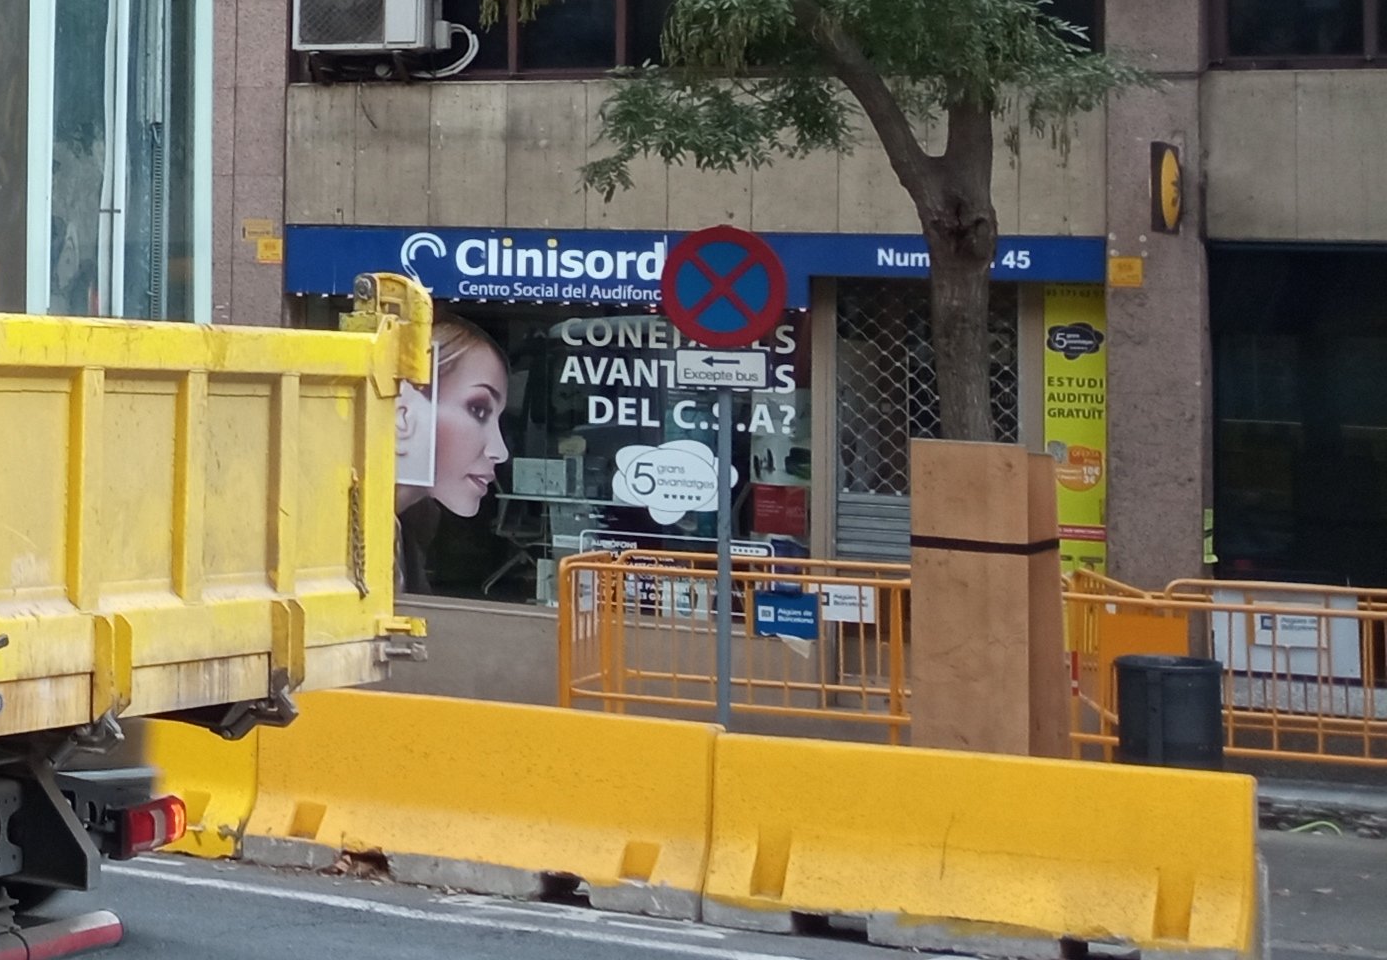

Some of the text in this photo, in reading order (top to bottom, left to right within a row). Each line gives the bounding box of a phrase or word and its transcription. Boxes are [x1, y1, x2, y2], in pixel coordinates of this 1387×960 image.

[455, 237, 665, 281] Clinisord
[1001, 250, 1031, 269] 45
[458, 280, 511, 297] Centro
[513, 281, 559, 299] Social
[561, 283, 587, 299] del
[1055, 332, 1067, 349] 5
[683, 368, 759, 382] Excepte bus
[1047, 376, 1104, 389] ESTUDI
[1047, 392, 1104, 404] AUDITIU
[588, 395, 660, 428] DEL
[631, 461, 657, 496] 5
